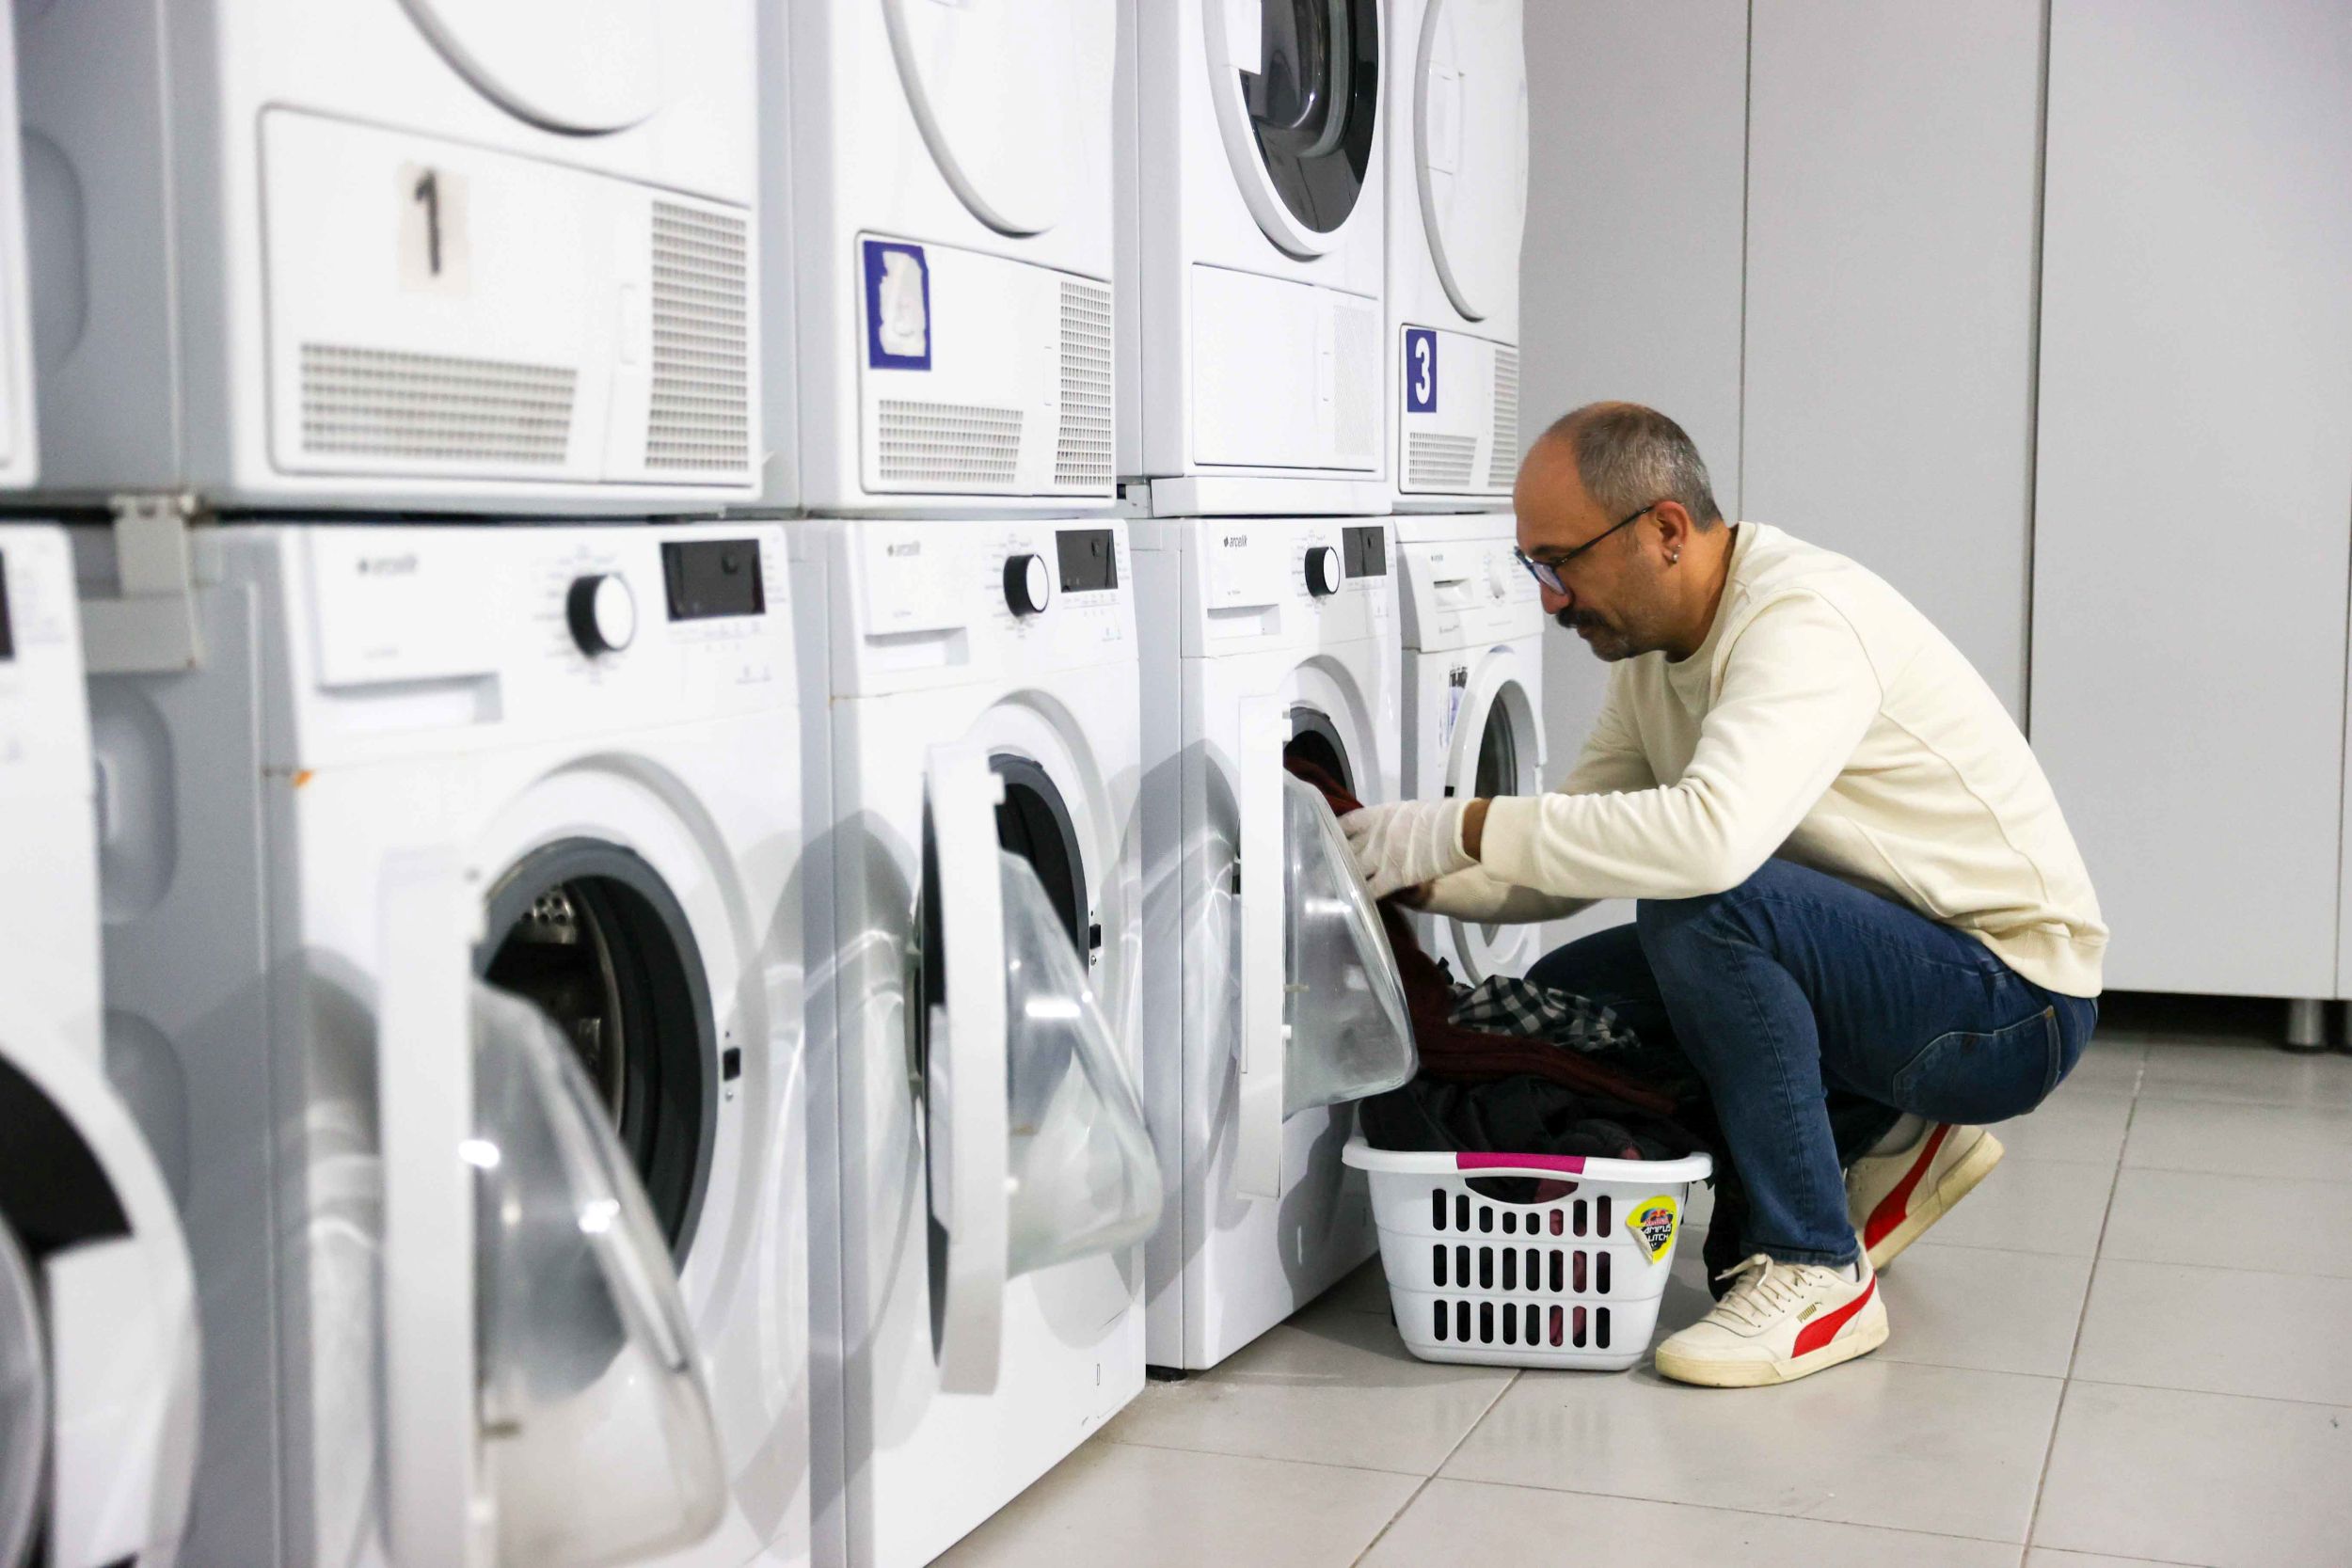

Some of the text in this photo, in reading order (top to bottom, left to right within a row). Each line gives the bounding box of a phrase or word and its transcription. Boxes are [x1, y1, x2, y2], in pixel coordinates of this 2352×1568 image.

[414, 169, 441, 276] 1
[1415, 337, 1431, 404] 3
[1643, 1224, 1672, 1234] AMPUS
